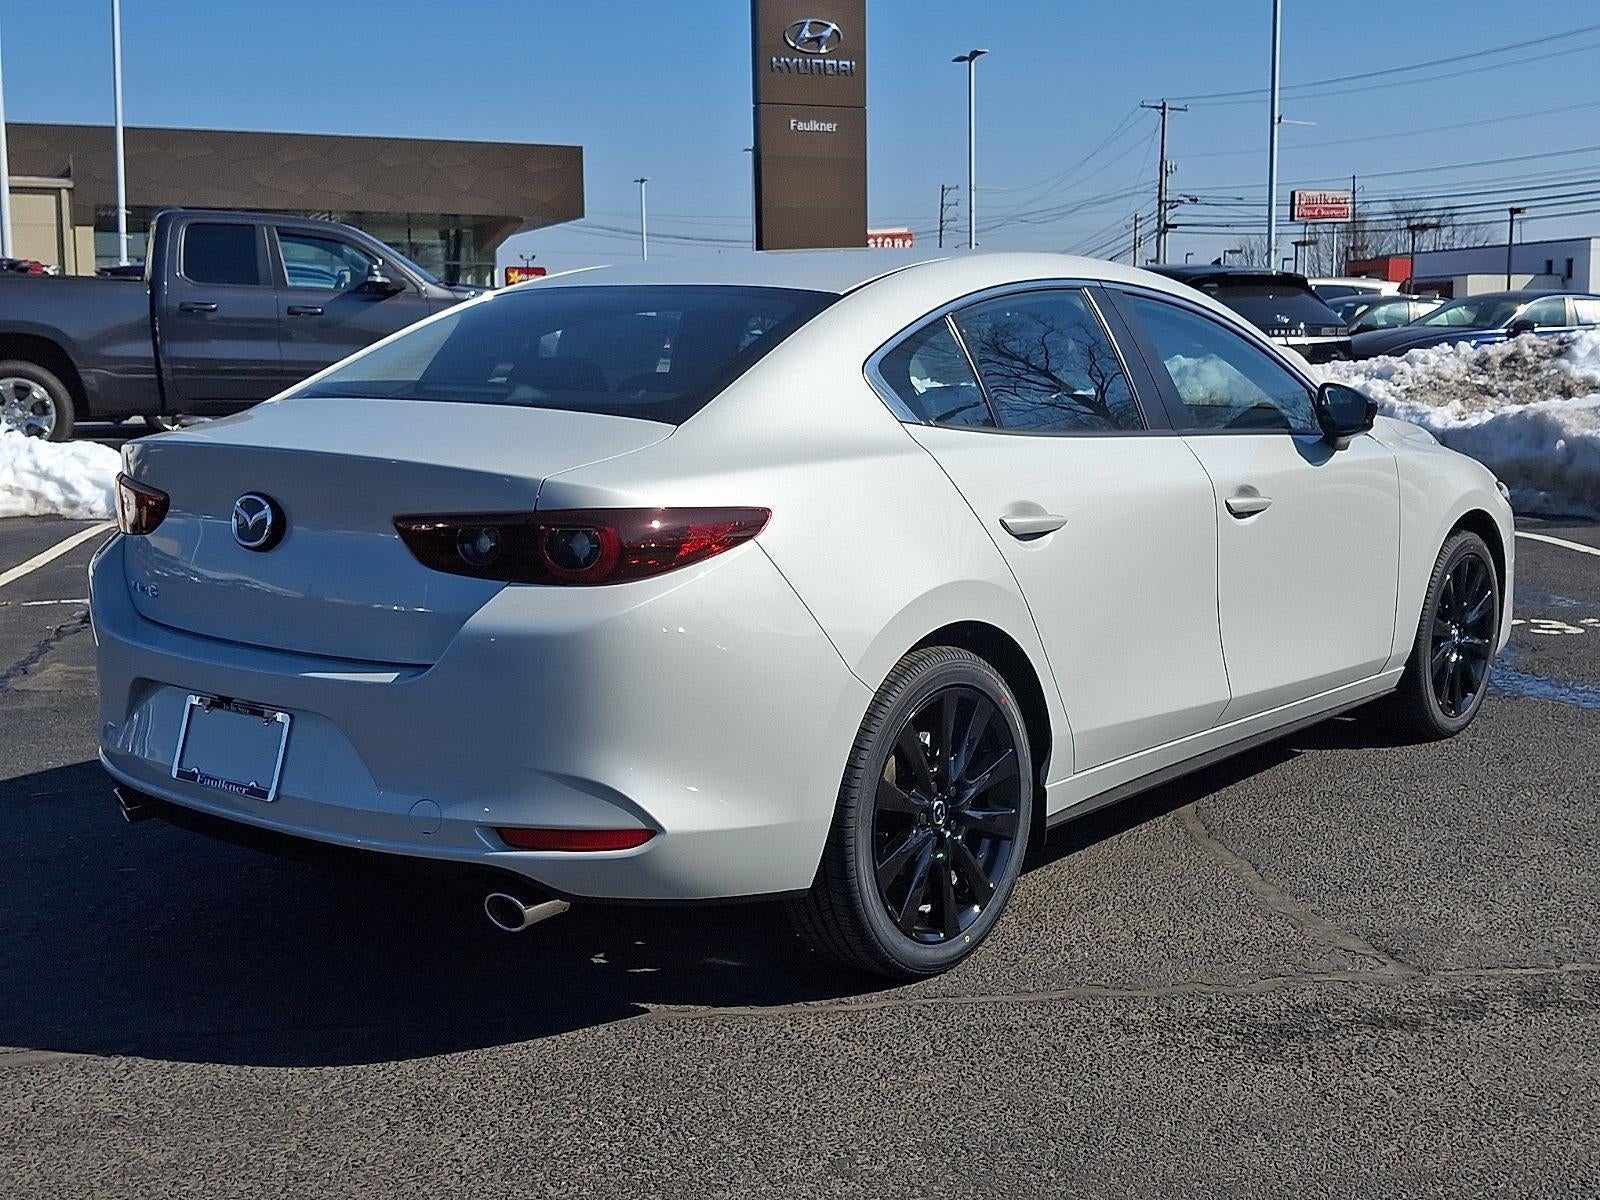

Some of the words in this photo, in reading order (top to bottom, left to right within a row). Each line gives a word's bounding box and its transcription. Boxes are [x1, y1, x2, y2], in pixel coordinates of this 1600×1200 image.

[772, 57, 855, 77] HYUNDAI
[790, 119, 838, 132] Faulkner
[1298, 192, 1349, 205] Faulkner
[196, 774, 249, 795] Faulkner
